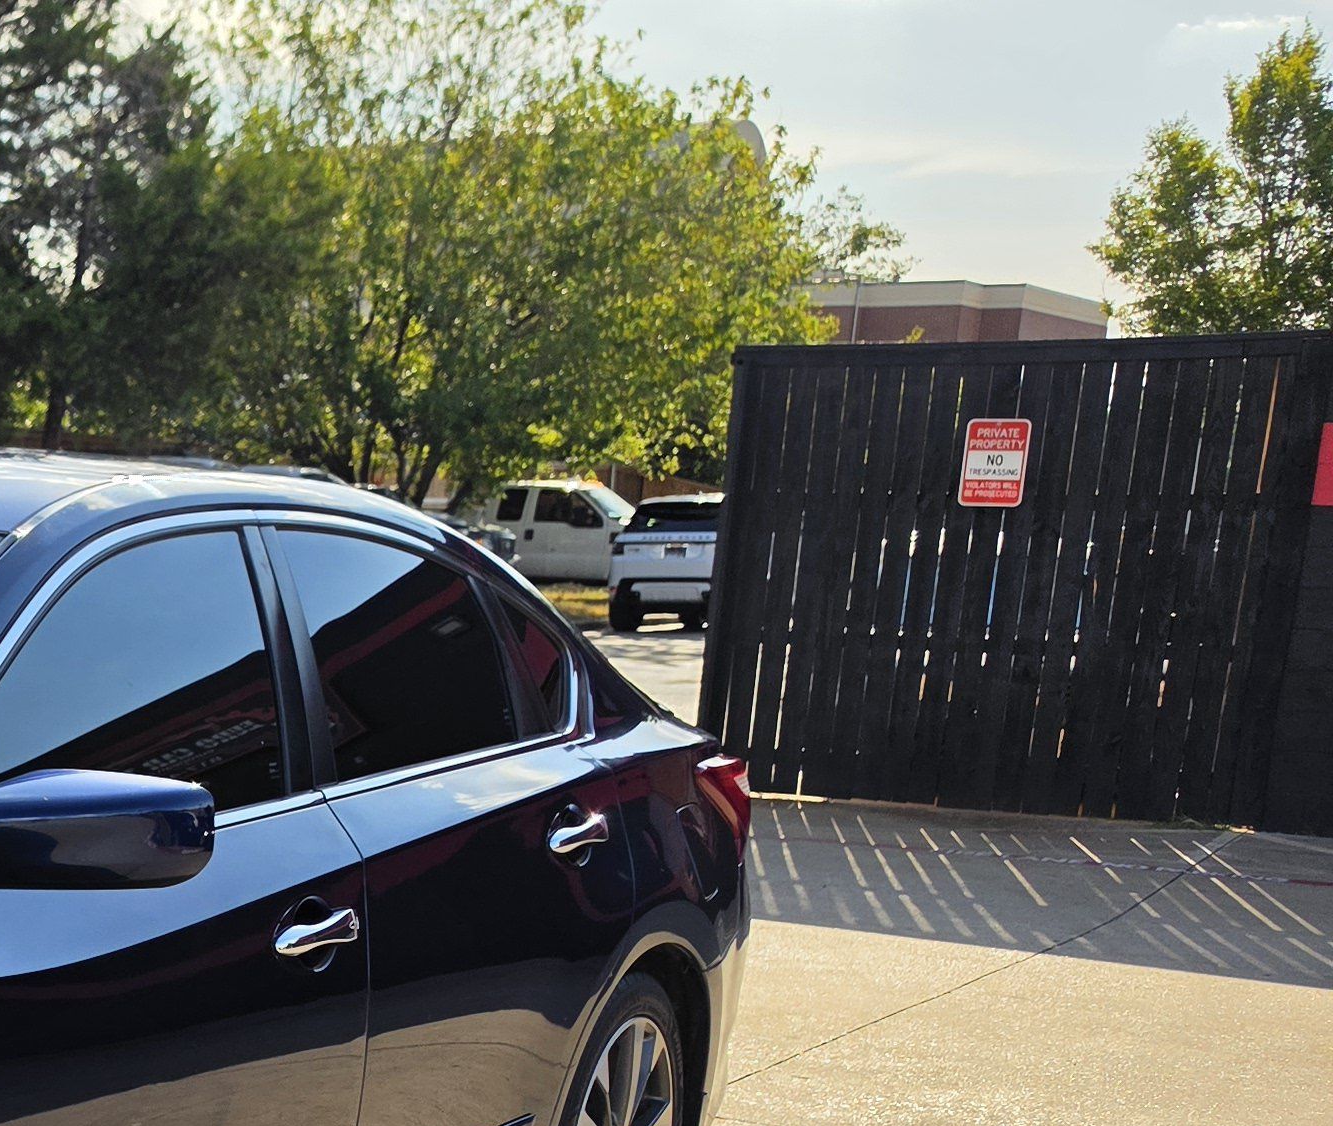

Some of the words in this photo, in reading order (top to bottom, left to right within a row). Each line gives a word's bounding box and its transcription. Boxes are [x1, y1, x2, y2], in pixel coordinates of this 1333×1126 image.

[976, 428, 1020, 438] PRIVATE
[969, 439, 1025, 449] PROPERTY
[986, 454, 1004, 466] NO
[969, 468, 1019, 476] TRESPASSING
